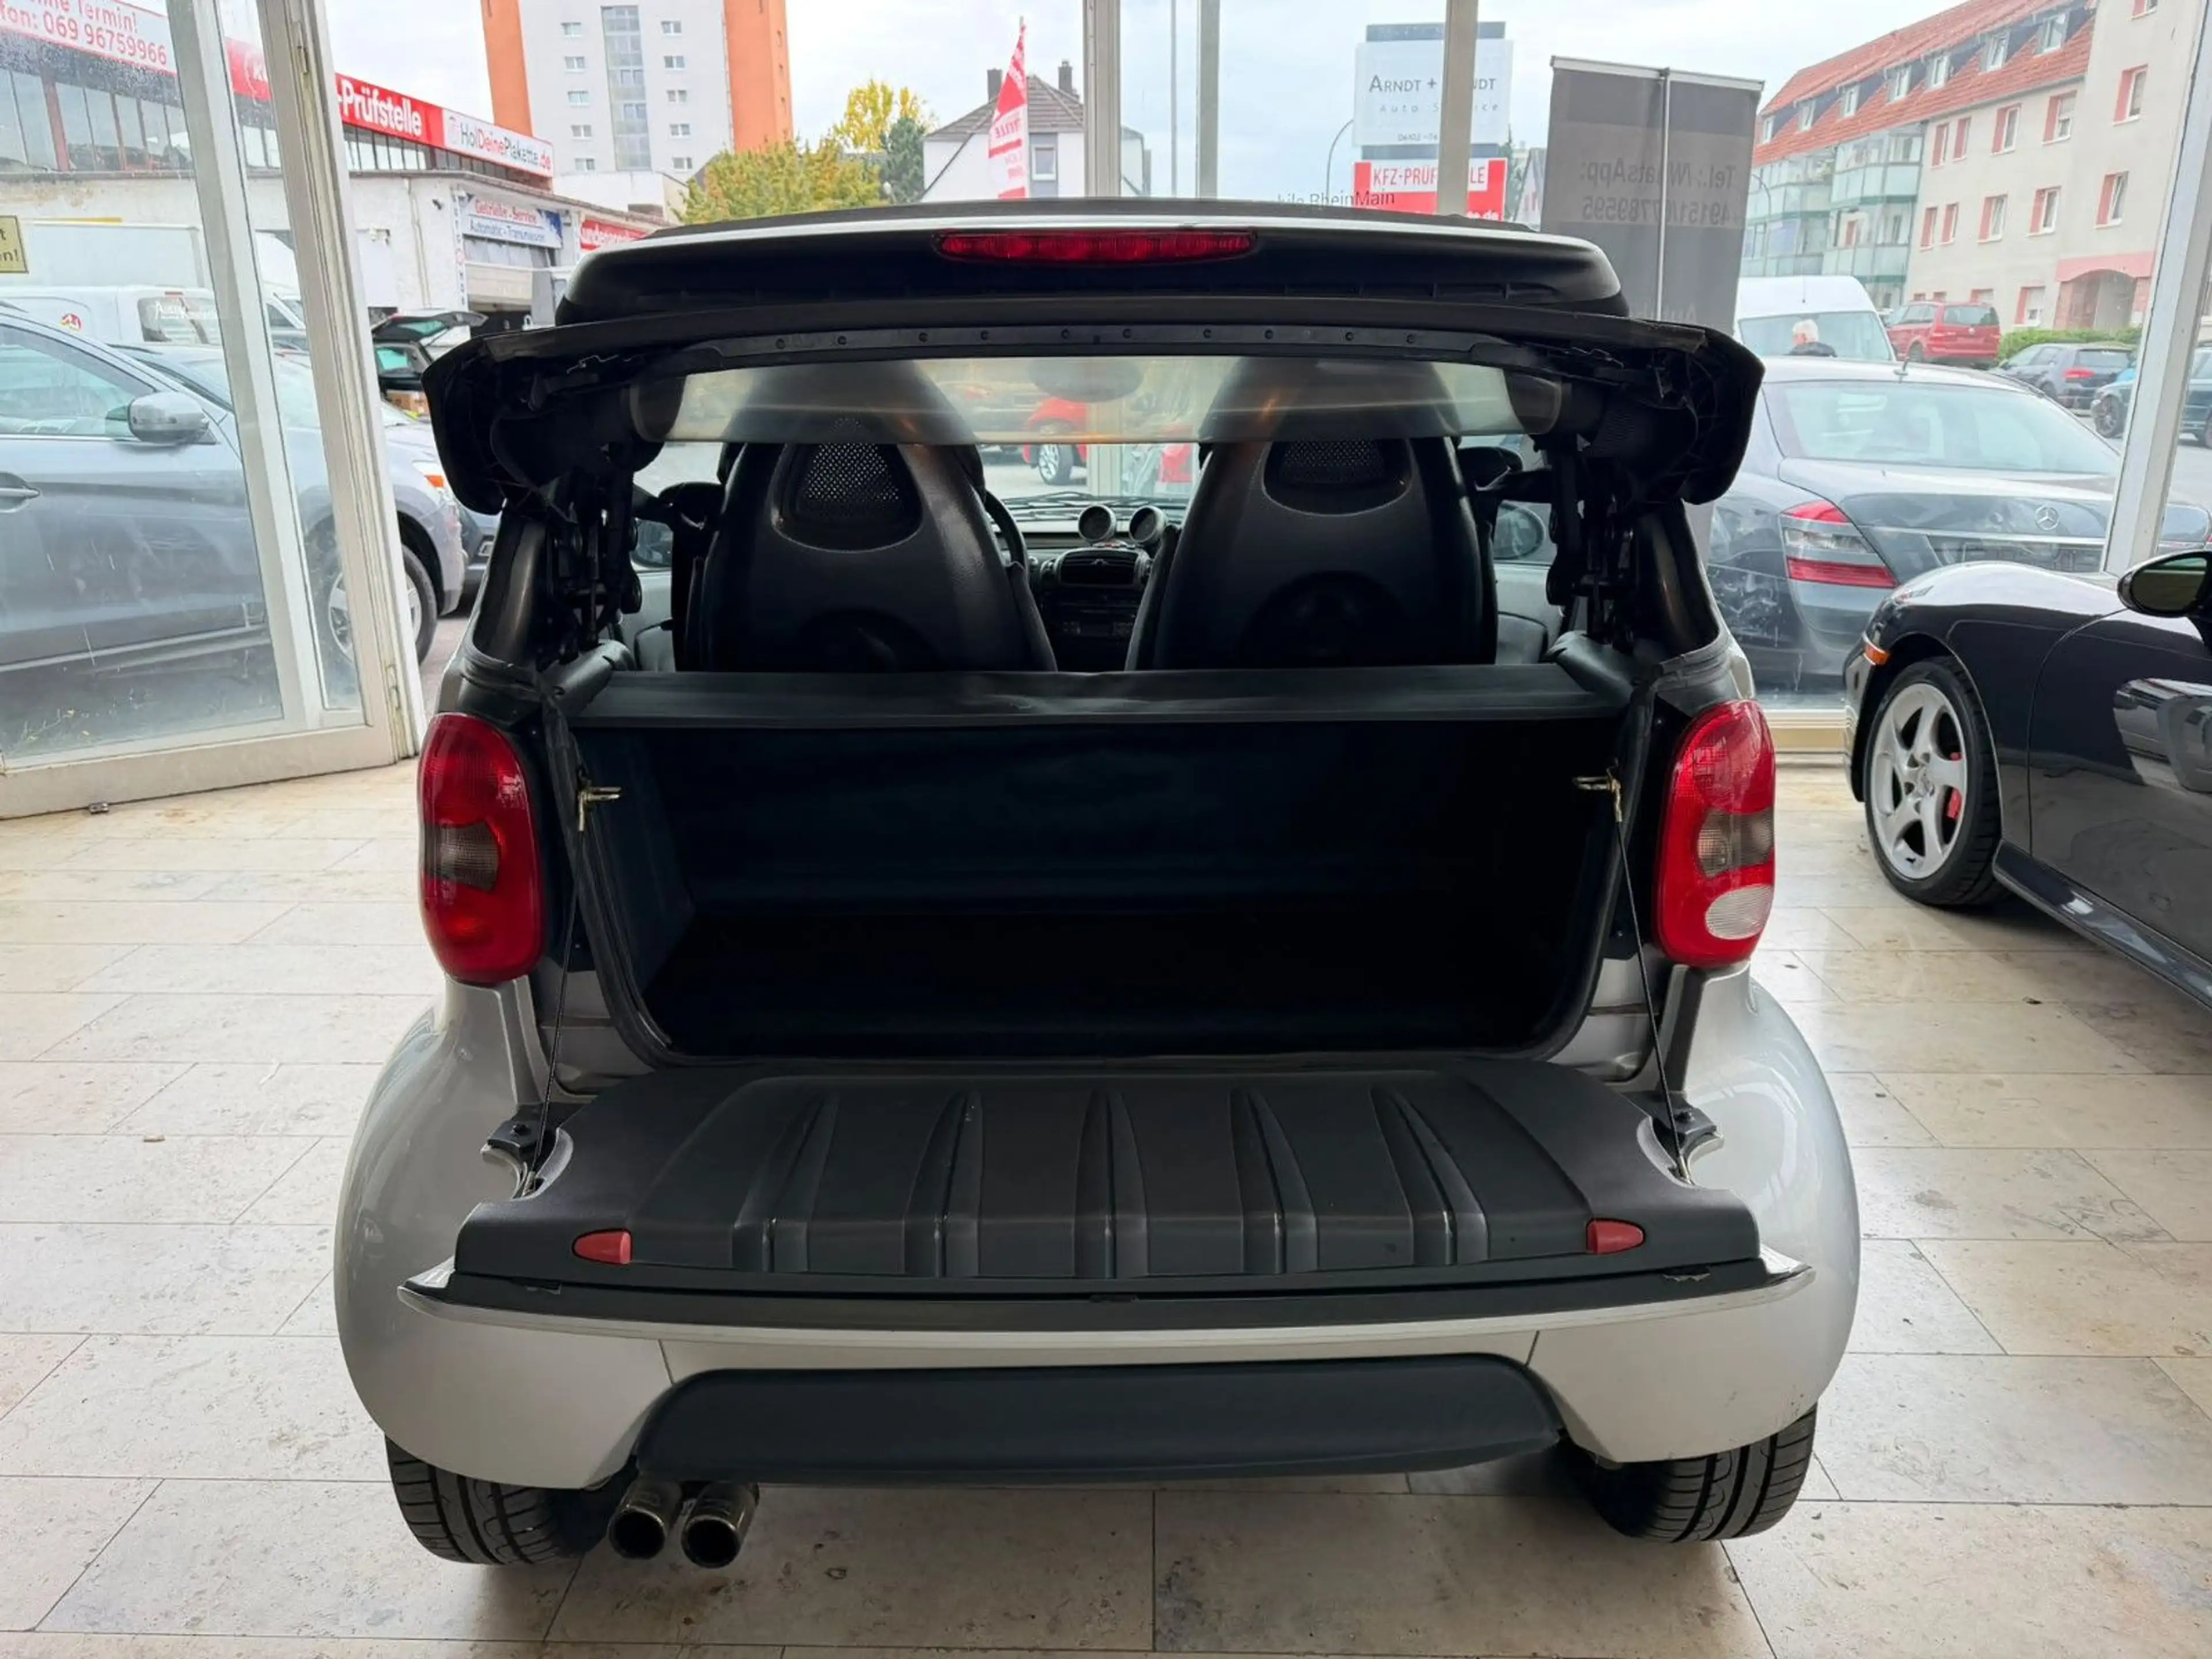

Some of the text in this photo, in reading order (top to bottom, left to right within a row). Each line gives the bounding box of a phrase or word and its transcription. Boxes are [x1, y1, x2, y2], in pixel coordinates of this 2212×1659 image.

[43, 10, 78, 40] 069
[84, 23, 167, 65] 96759966
[1369, 74, 1422, 92] ARNDT
